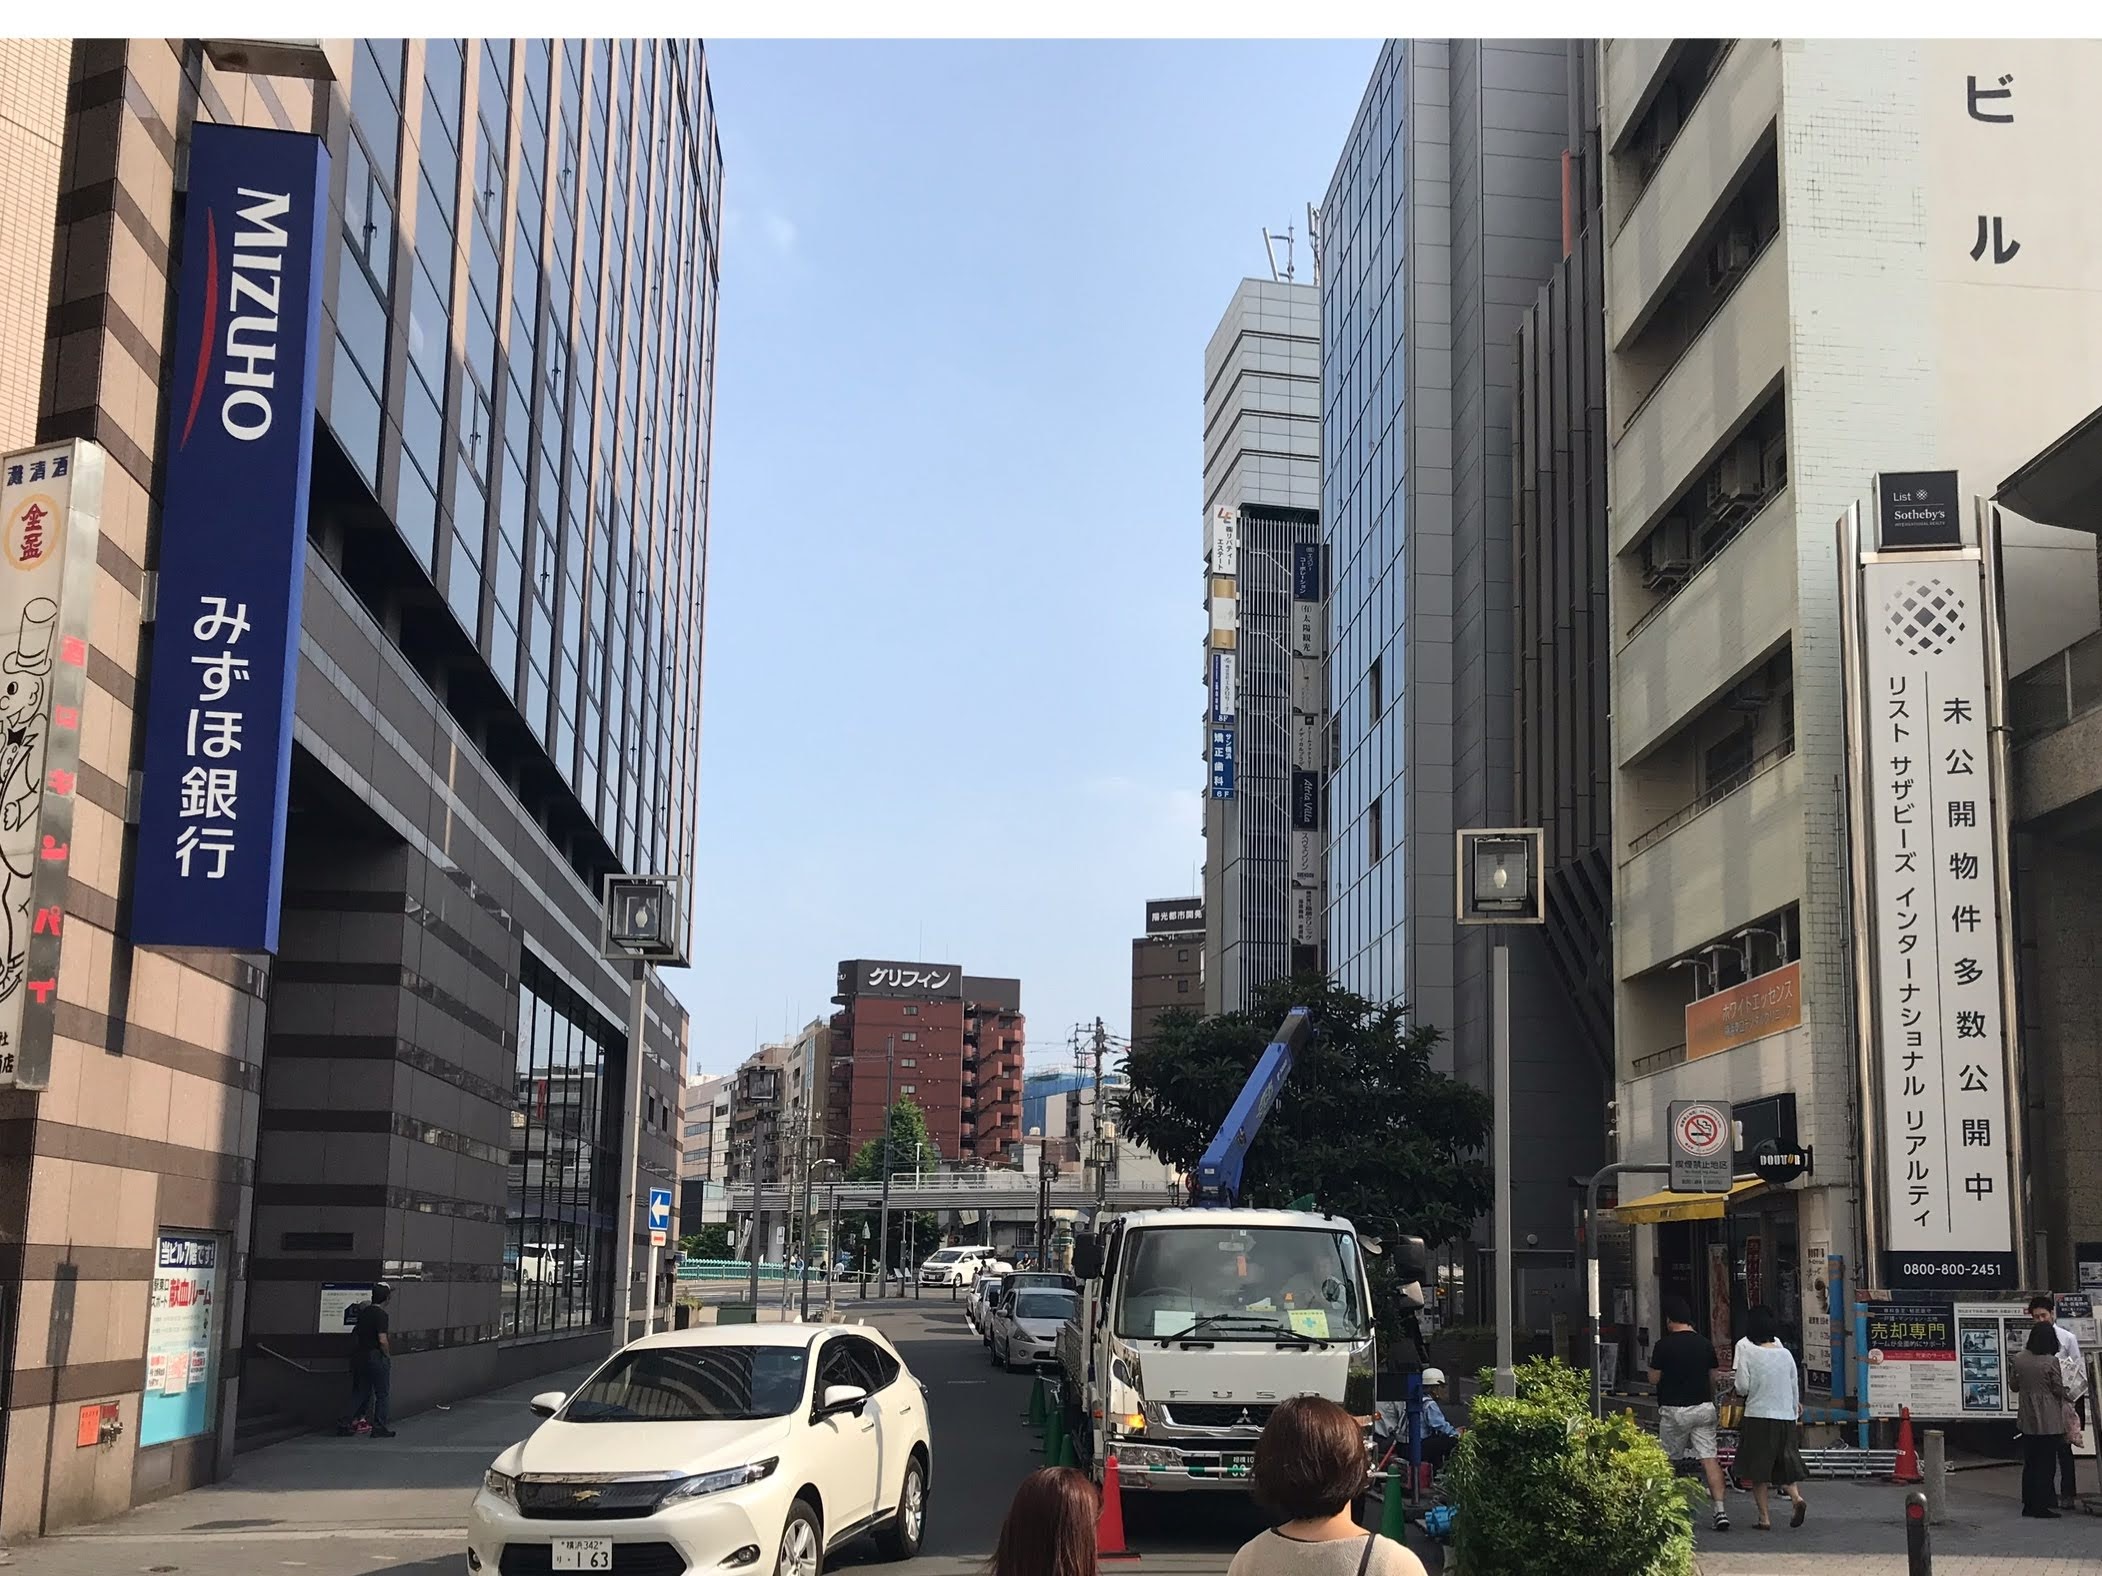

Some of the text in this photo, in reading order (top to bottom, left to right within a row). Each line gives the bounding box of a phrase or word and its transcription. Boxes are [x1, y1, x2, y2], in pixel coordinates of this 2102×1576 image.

[1967, 74, 2021, 264] ビル
[221, 187, 290, 440] MIZUHO
[1893, 492, 1912, 502] List
[1894, 509, 1946, 521] Sotheby's
[176, 596, 251, 879] みずほ銀行
[1303, 779, 1313, 824] Atria Villa
[1889, 676, 1930, 1228] リスト サザビーズ インターナショナル リアルティ
[1943, 697, 1994, 1202] 未公開物件多数公開中
[868, 967, 951, 990] グリフィン
[1723, 981, 1793, 1021] ホワイトエッセンス
[0, 1053, 15, 1074] 店
[1760, 1153, 1801, 1166] DOUTOR
[1903, 1263, 2001, 1276] 0800-800-2451
[1870, 1322, 1946, 1341] 売却専門
